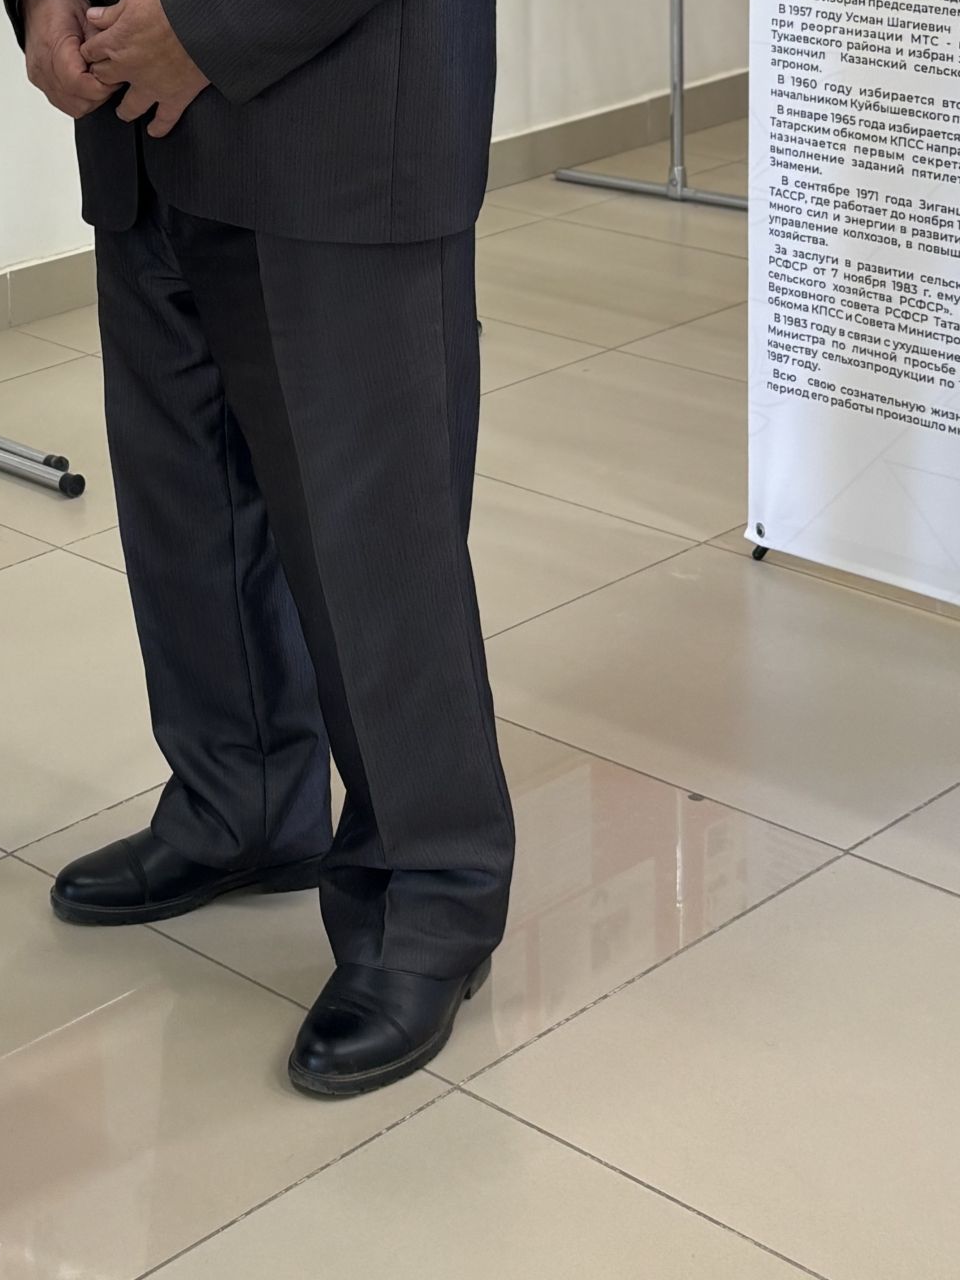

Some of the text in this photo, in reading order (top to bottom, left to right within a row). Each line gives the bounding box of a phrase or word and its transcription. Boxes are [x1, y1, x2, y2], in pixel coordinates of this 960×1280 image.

[790, 5, 951, 33] 1957 году Усман Шагиевич
[801, 22, 902, 41] реорганизации
[771, 30, 953, 62] Тукаевского района избран
[771, 44, 906, 70] закончил Казанский
[771, 58, 822, 72] агроном.
[771, 88, 950, 122] начальником Куйбышевского
[791, 76, 934, 105] 1960 году избирается
[770, 117, 924, 150] Татарским обкомом КПСС
[787, 108, 885, 130] январе 1965 года
[770, 131, 904, 161] назначается первым
[770, 145, 904, 174] выполнение заданий
[770, 157, 822, 175] Знамени.
[769, 187, 953, 229] ТАССР, работает ноября
[794, 180, 912, 207] сентябре 1971 года
[769, 202, 895, 232] много энергии
[769, 215, 901, 248] управление колхозов,
[769, 228, 828, 246] хозяйства.
[769, 256, 917, 295] РСФСР ноября 1983
[792, 250, 914, 280] заслуги развитии
[768, 271, 952, 316] сельского хозяйства РСФСР».
[769, 282, 928, 323] Верховного совета РСФСР
[768, 297, 895, 331] обкома КПСС Совета
[783, 315, 881, 345] 1983 году связи
[767, 350, 820, 371] 1987 году.
[768, 325, 956, 375] Министра личной просьбе
[768, 340, 934, 384] качеству сельхозпродукции
[767, 381, 945, 431] период работы произошло
[808, 377, 925, 413] свою сознательную
